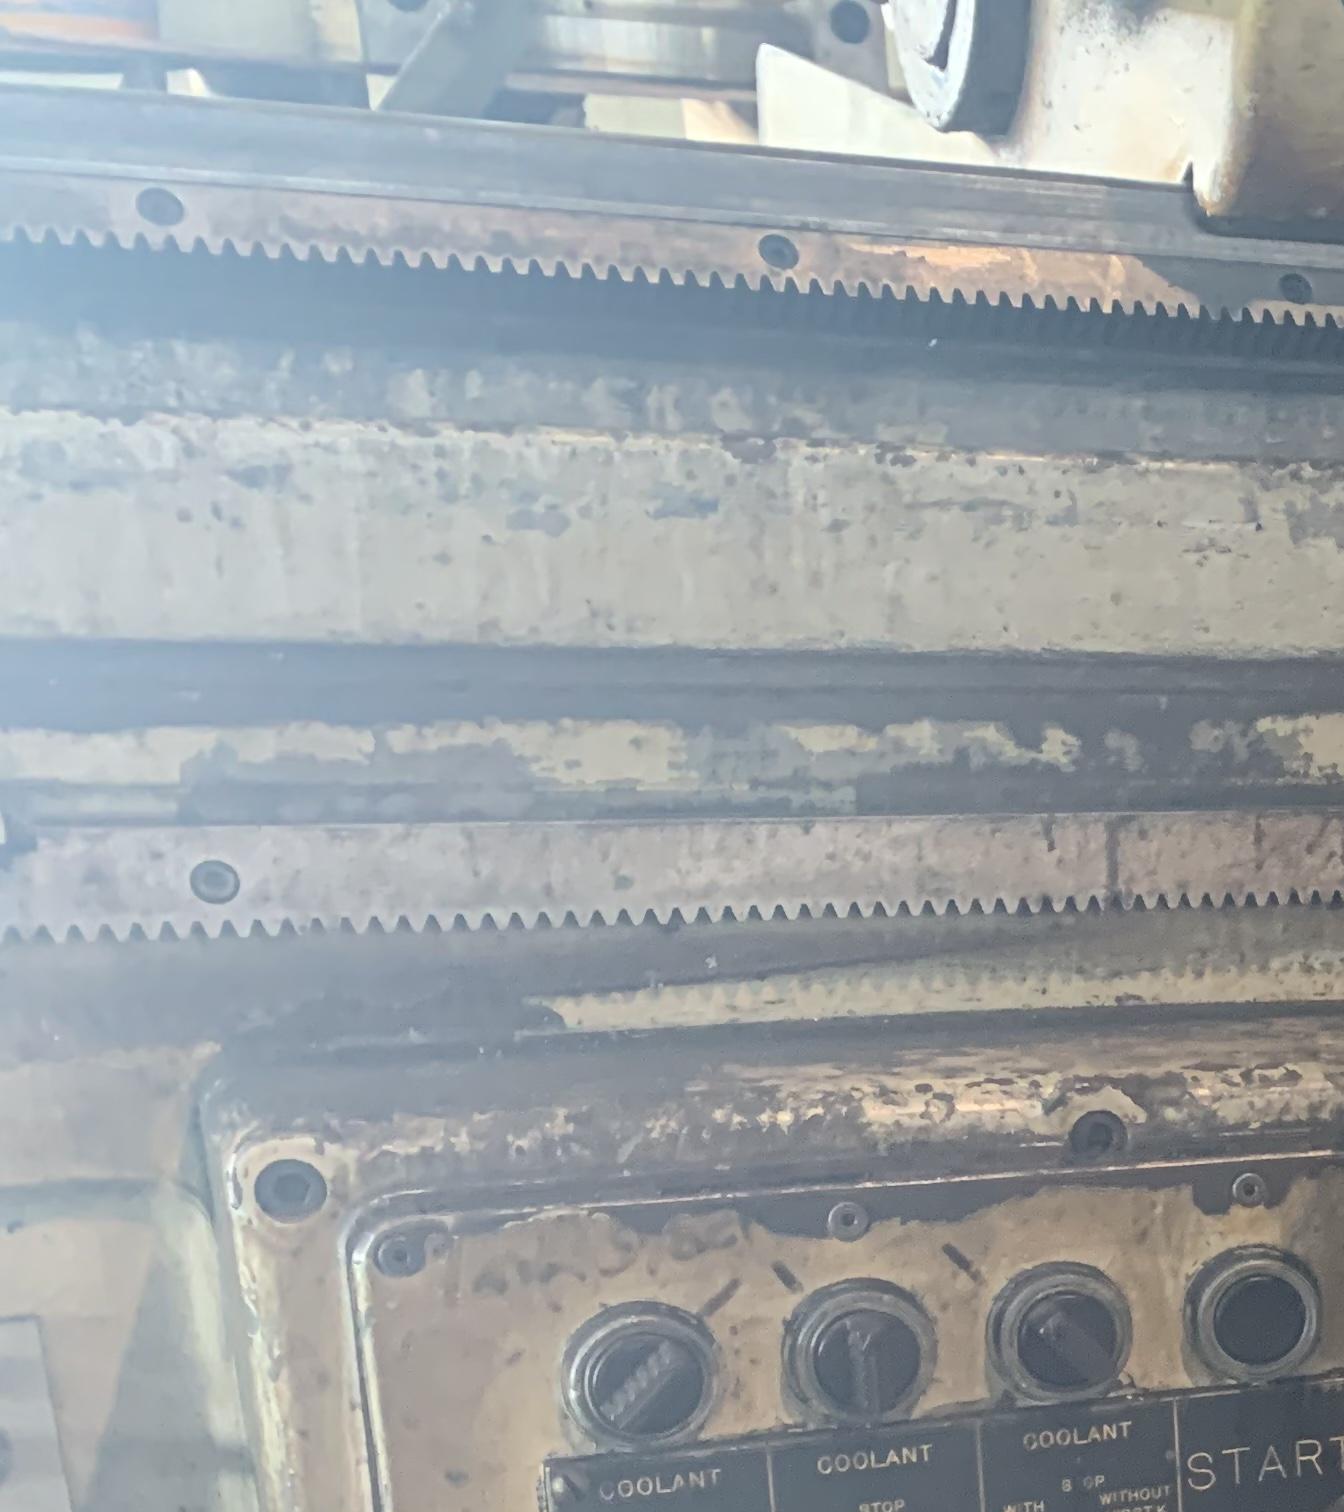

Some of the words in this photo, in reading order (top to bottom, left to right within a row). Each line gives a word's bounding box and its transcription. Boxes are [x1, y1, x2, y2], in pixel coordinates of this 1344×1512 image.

[1023, 1421, 1133, 1451] COOLANT
[816, 1443, 933, 1475] COOLANT
[600, 1468, 722, 1501] COOLANT
[1099, 1484, 1171, 1506] WITHOUT
